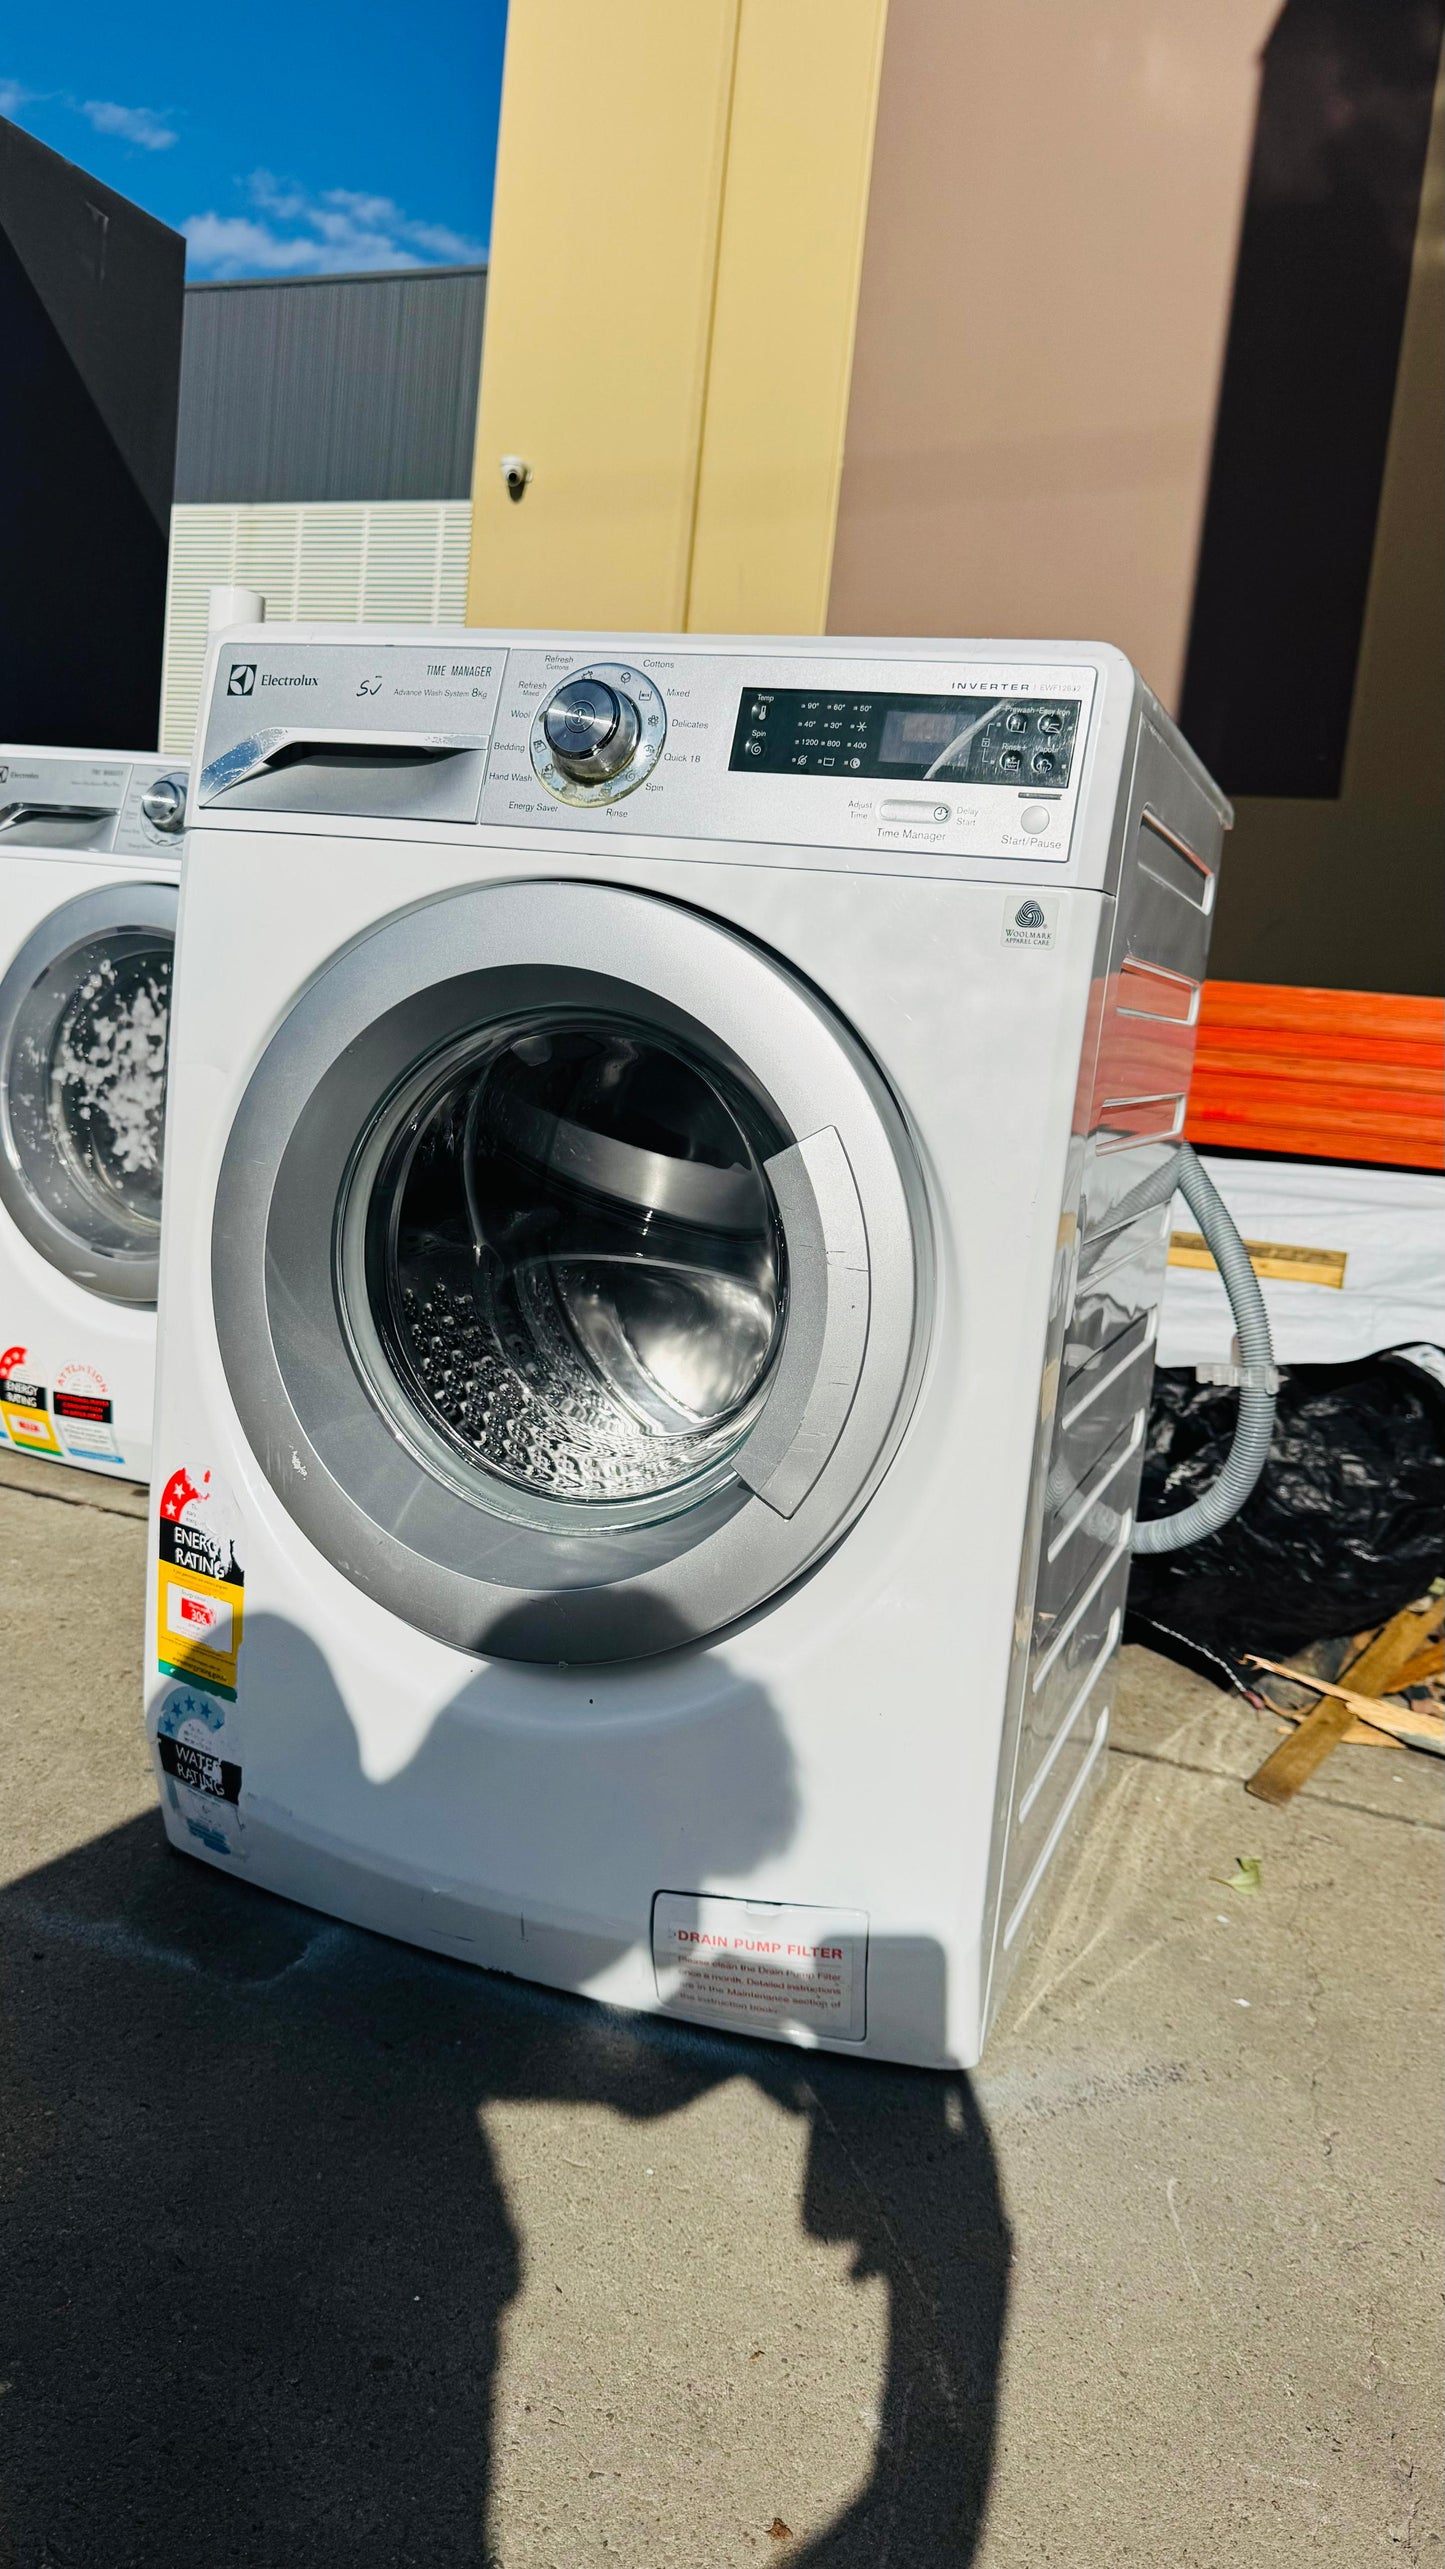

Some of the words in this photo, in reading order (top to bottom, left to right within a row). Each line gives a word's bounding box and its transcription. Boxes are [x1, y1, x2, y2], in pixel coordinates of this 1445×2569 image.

[545, 655, 574, 664] Refresh
[643, 659, 674, 669] Cottons
[426, 665, 446, 676] TIME
[450, 665, 492, 677] MANAGER
[261, 674, 319, 688] Electrolux
[518, 680, 547, 689] Refresh
[951, 682, 1030, 691] INVERTER
[393, 688, 422, 697] Advance
[424, 688, 443, 697] Wash
[444, 689, 469, 699] System
[666, 688, 690, 698] Mixed
[757, 693, 774, 703] Temp
[511, 709, 530, 719] Wool
[1005, 705, 1035, 714] Prewash
[672, 719, 709, 729] Delicates
[752, 729, 767, 738] Spin
[494, 742, 525, 753] Bedding
[826, 740, 841, 748] 800
[853, 741, 867, 749] 400
[664, 752, 686, 763] Quick
[690, 754, 701, 763] 18
[489, 772, 512, 781] Hand
[513, 773, 533, 782] Wash
[645, 783, 664, 793] Spin
[508, 801, 534, 812] Energy
[536, 802, 558, 813] Saver
[848, 800, 873, 810] Adjust
[606, 808, 628, 818] Rinse
[850, 811, 868, 819] Time
[956, 806, 979, 816] Delay
[956, 818, 976, 826] Start
[876, 828, 900, 838] Time
[902, 829, 946, 842] Manager
[1001, 834, 1062, 849] Start/Pause
[1005, 929, 1052, 939] WOOLMARK
[175, 1547, 225, 1579] RATING
[177, 1763, 225, 1796] RATING
[678, 1930, 728, 1947] DRAIN
[734, 1938, 781, 1953] PUMP
[787, 1944, 842, 1960] FILTER
[678, 1955, 709, 1966] Please
[712, 1961, 738, 1970] clean
[740, 1964, 756, 1972] the
[758, 1966, 783, 1976] Drain
[786, 1969, 815, 1980] Pump
[817, 1973, 841, 1981] Filter
[747, 1978, 785, 1989] Detailed
[787, 1984, 841, 1995] instructions
[680, 1992, 695, 2000] the
[697, 1997, 747, 2009] instruction
[697, 1983, 706, 1991] in
[708, 1985, 724, 1993] the
[727, 1988, 790, 2003] Maintenance
[792, 1998, 827, 2008] section
[831, 2001, 841, 2009] of
